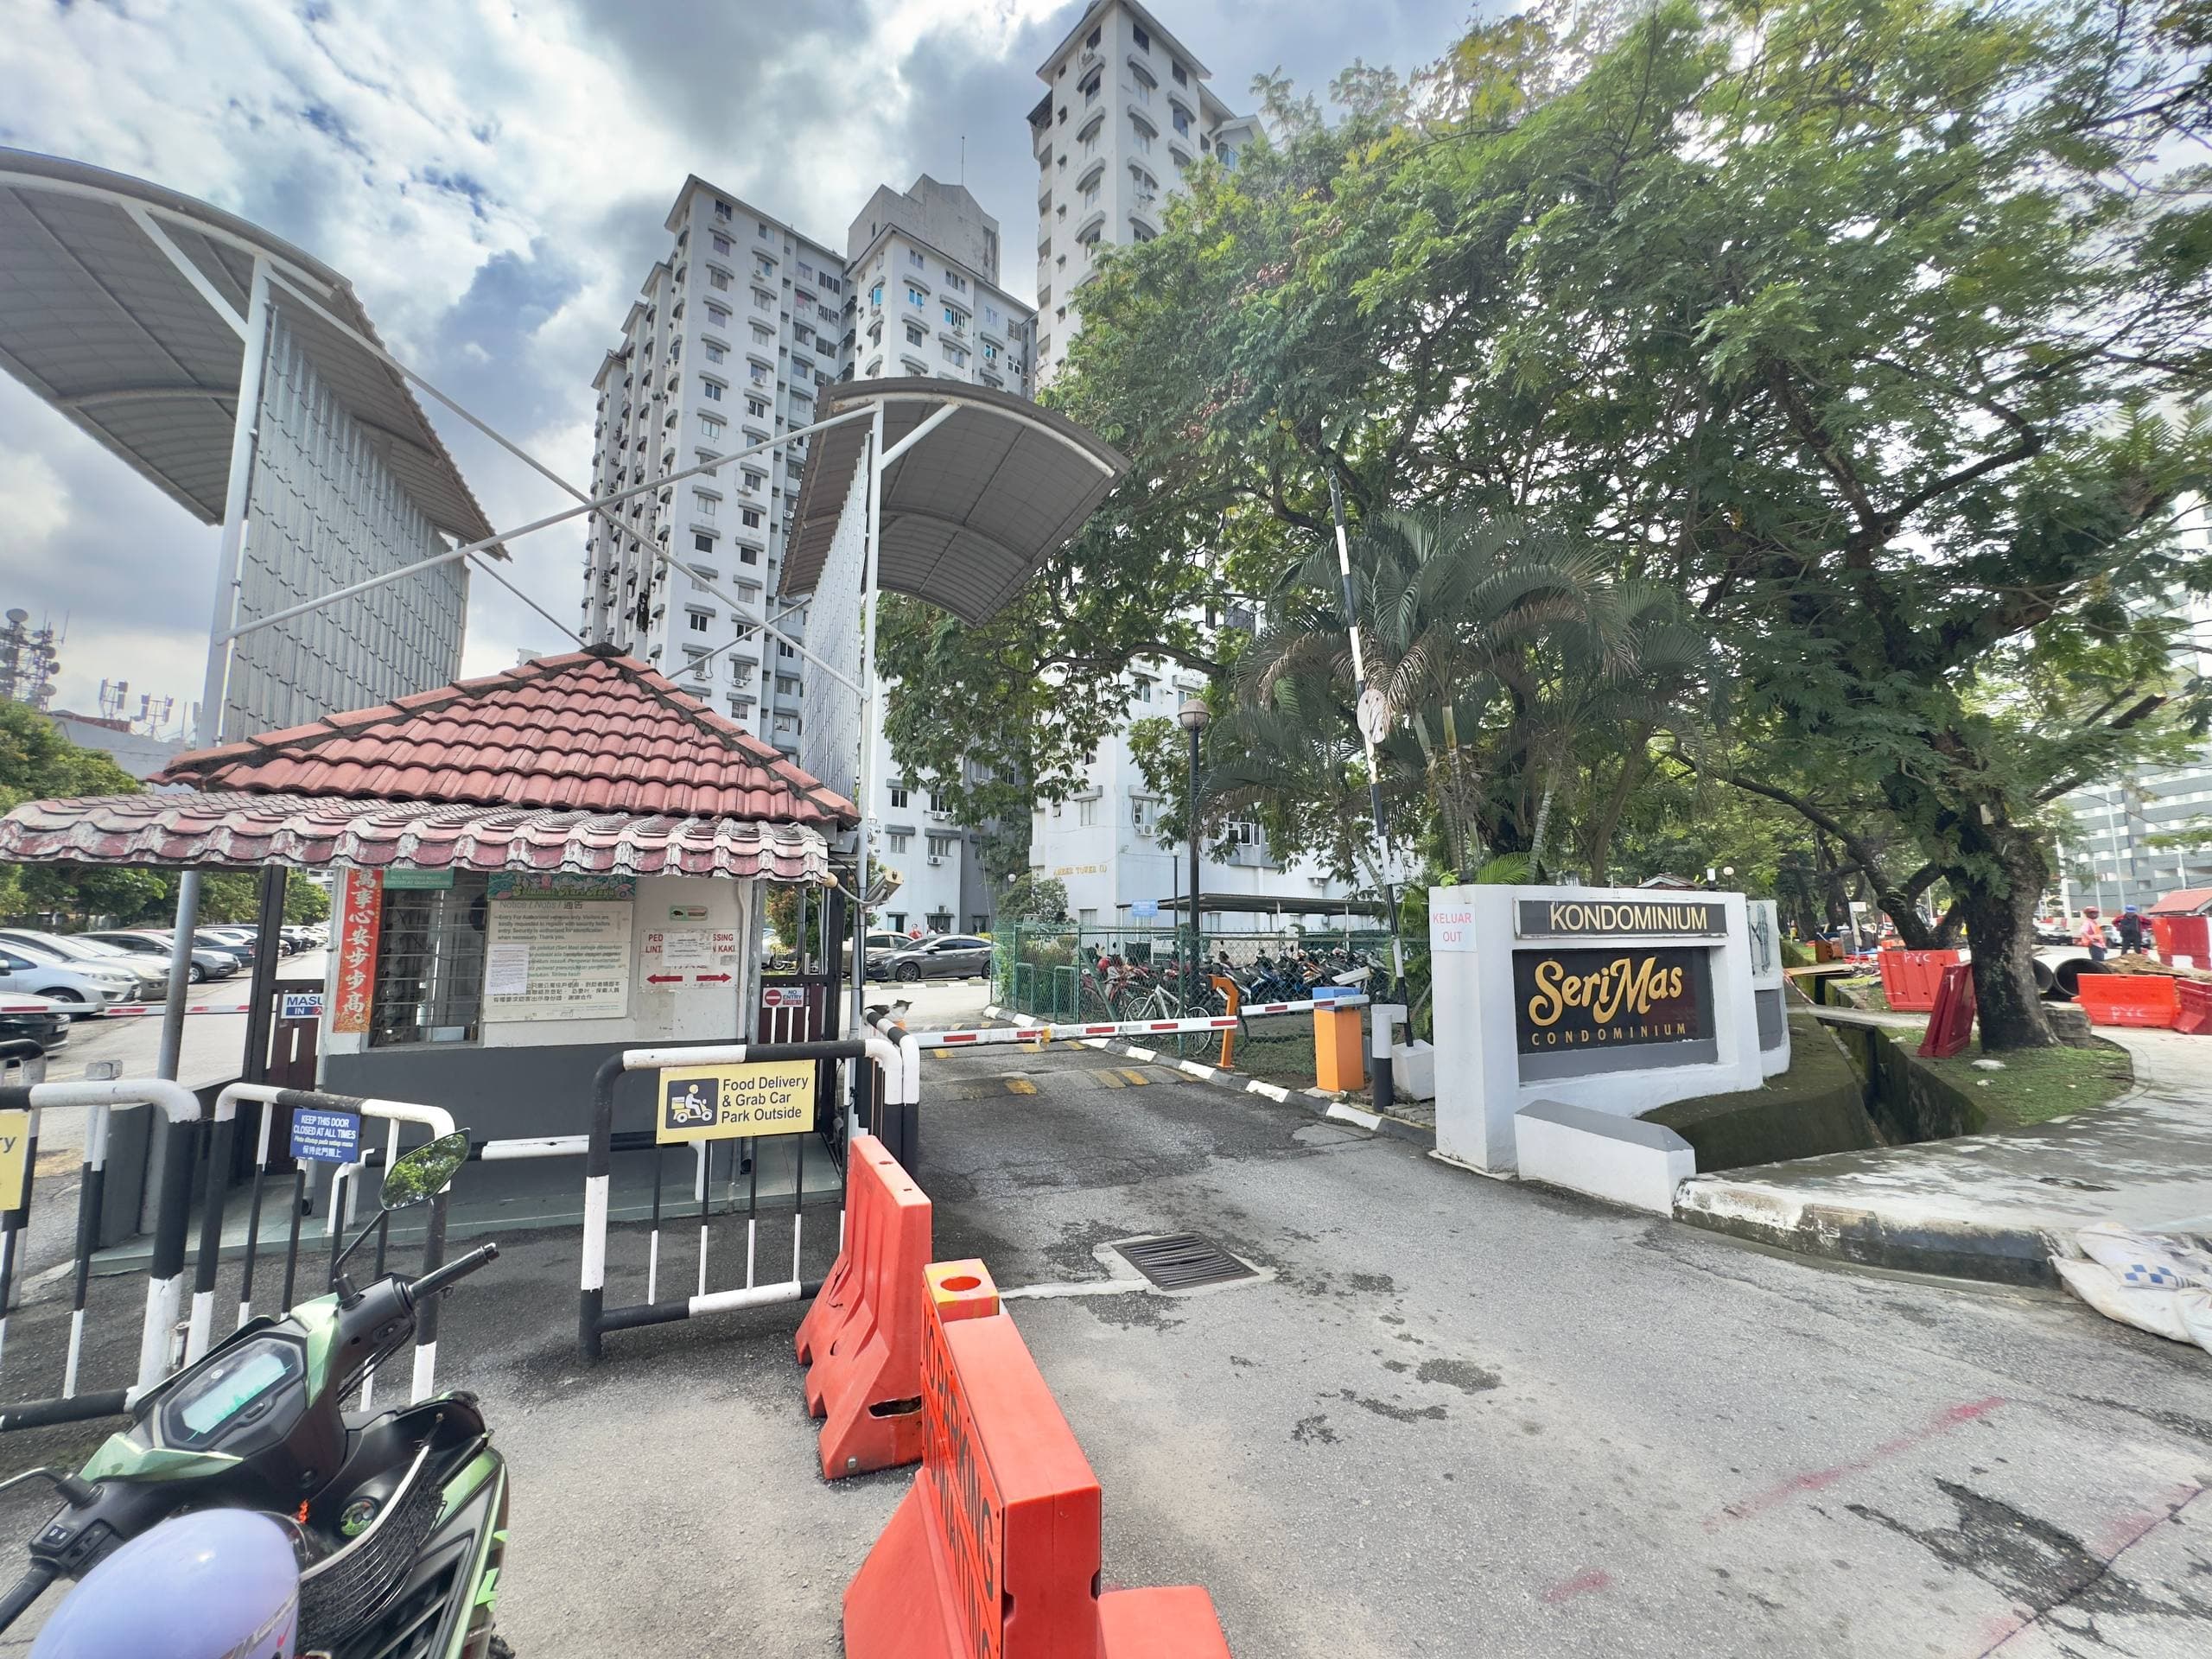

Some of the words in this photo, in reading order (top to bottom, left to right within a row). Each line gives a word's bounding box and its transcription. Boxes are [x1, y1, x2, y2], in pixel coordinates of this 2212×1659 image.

[1433, 912, 1471, 925] KELUAR
[1550, 904, 1708, 931] KONDOMINIUM
[1442, 931, 1462, 942] OUT
[287, 995, 323, 1006] MASU
[1532, 1023, 1686, 1046] CONDOMINIUM
[723, 1077, 755, 1091] Food
[759, 1075, 810, 1090] Delivery
[722, 1094, 732, 1107] &
[735, 1092, 766, 1106] Grab
[770, 1091, 791, 1104] Car
[301, 1115, 317, 1125] KEEP
[317, 1116, 330, 1126] THIS
[331, 1117, 350, 1128] DOOR
[721, 1109, 750, 1123] Park
[754, 1106, 803, 1121] Outside
[293, 1125, 316, 1135] CLOSED
[316, 1128, 325, 1136] AT
[325, 1128, 336, 1138] ALL
[337, 1129, 356, 1140] TIMES
[938, 1347, 994, 1602] PARKING
